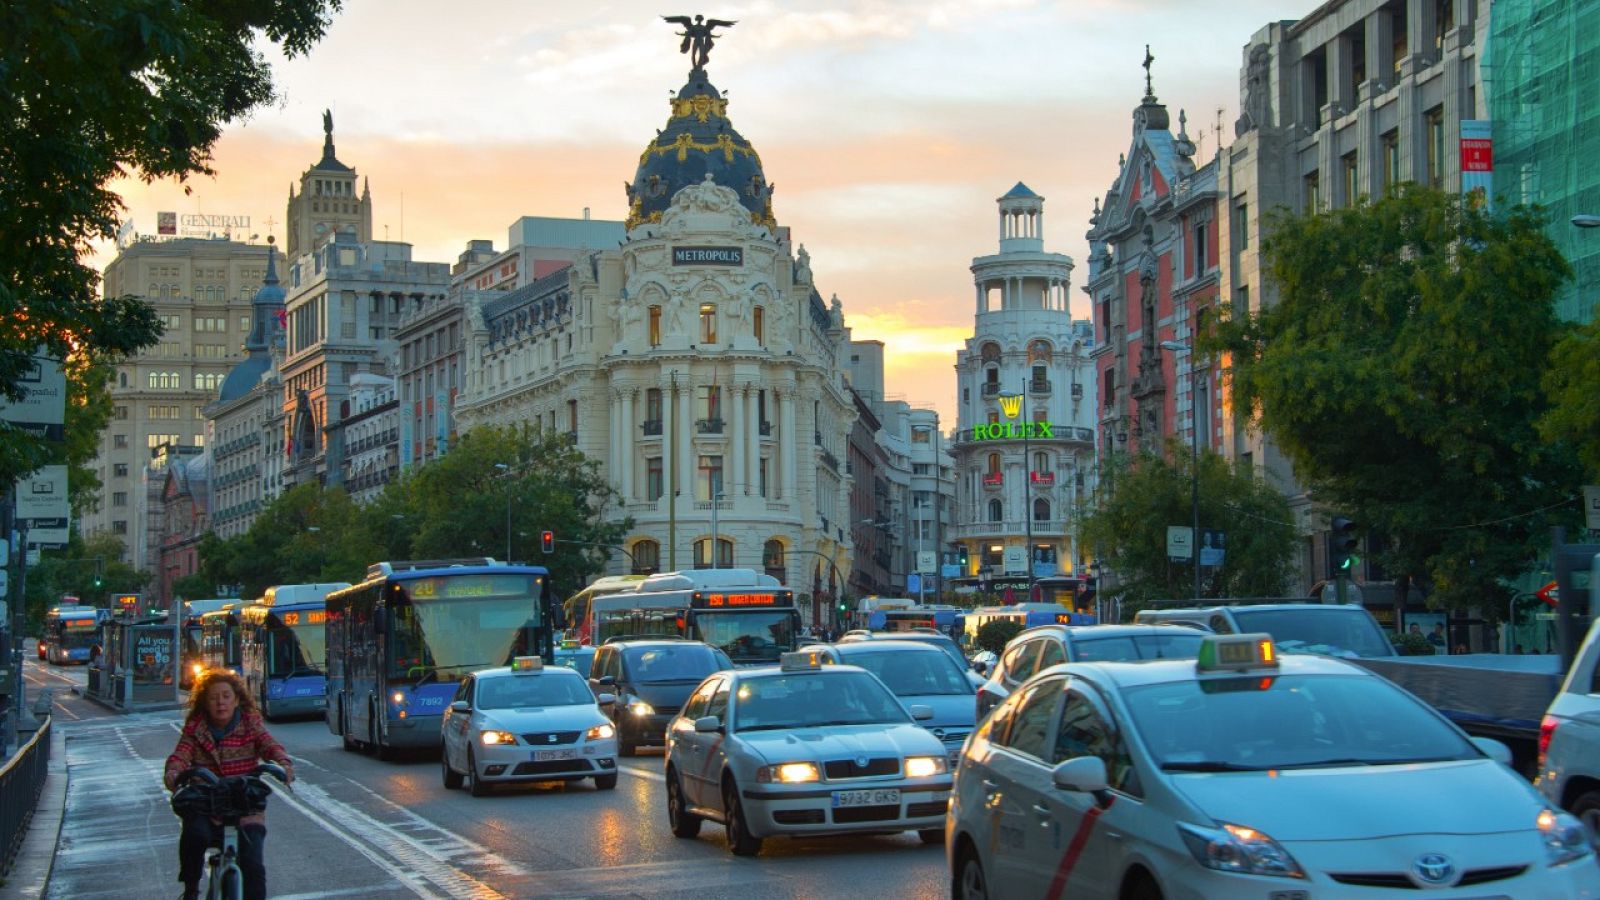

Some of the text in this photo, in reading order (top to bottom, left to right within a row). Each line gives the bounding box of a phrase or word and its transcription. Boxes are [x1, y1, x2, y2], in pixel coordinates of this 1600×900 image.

[181, 214, 251, 229] GENERALI
[676, 250, 741, 262] METROPOLIS
[974, 422, 1053, 441] ROLEX
[284, 613, 299, 625] 52
[138, 637, 170, 647] All you
[1260, 641, 1272, 661] 1
[137, 654, 170, 666] Love
[421, 698, 443, 706] 7892
[840, 791, 898, 805] 9732 GKS
